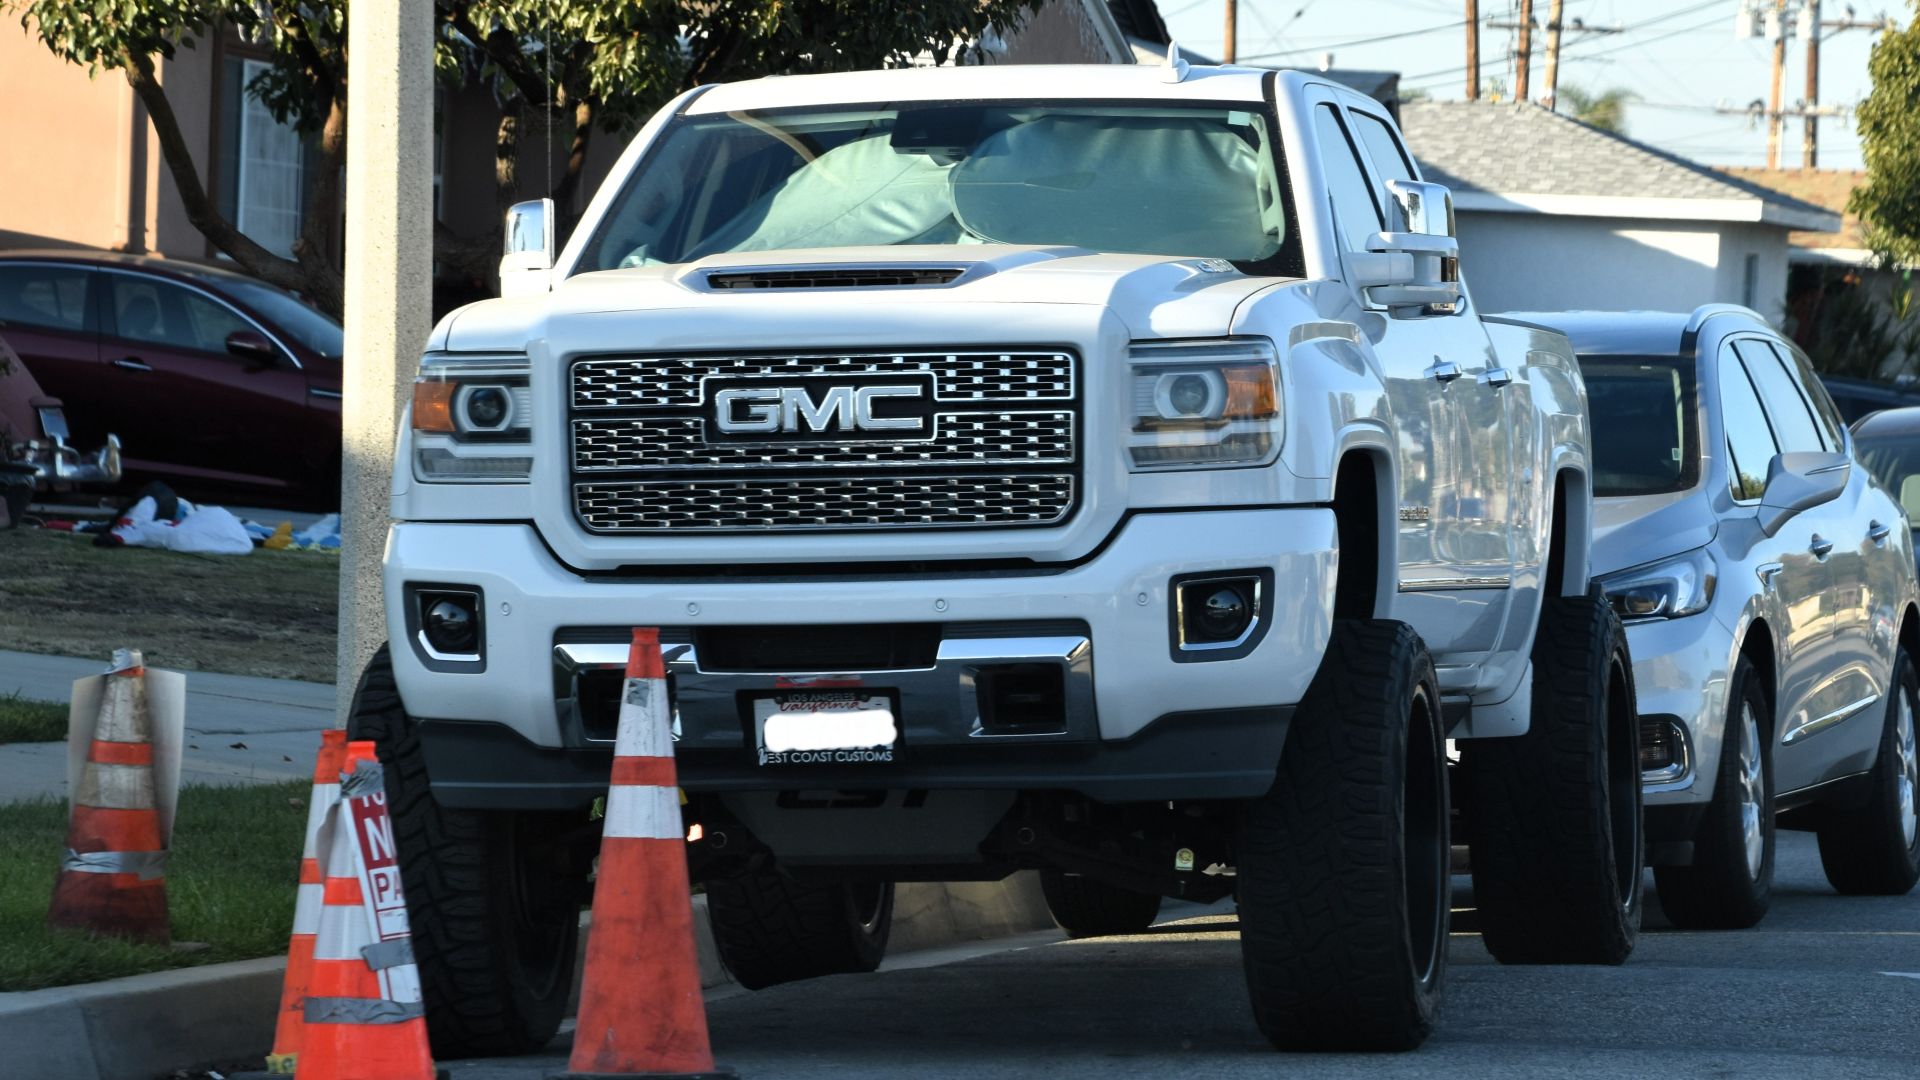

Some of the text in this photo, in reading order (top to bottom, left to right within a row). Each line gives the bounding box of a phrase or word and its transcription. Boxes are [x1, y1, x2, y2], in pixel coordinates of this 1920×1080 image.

[715, 385, 923, 434] GMC
[788, 692, 857, 702] LOS ANGELES
[780, 700, 862, 713] California
[791, 752, 832, 763] COAST
[835, 750, 893, 762] CUSTOMS
